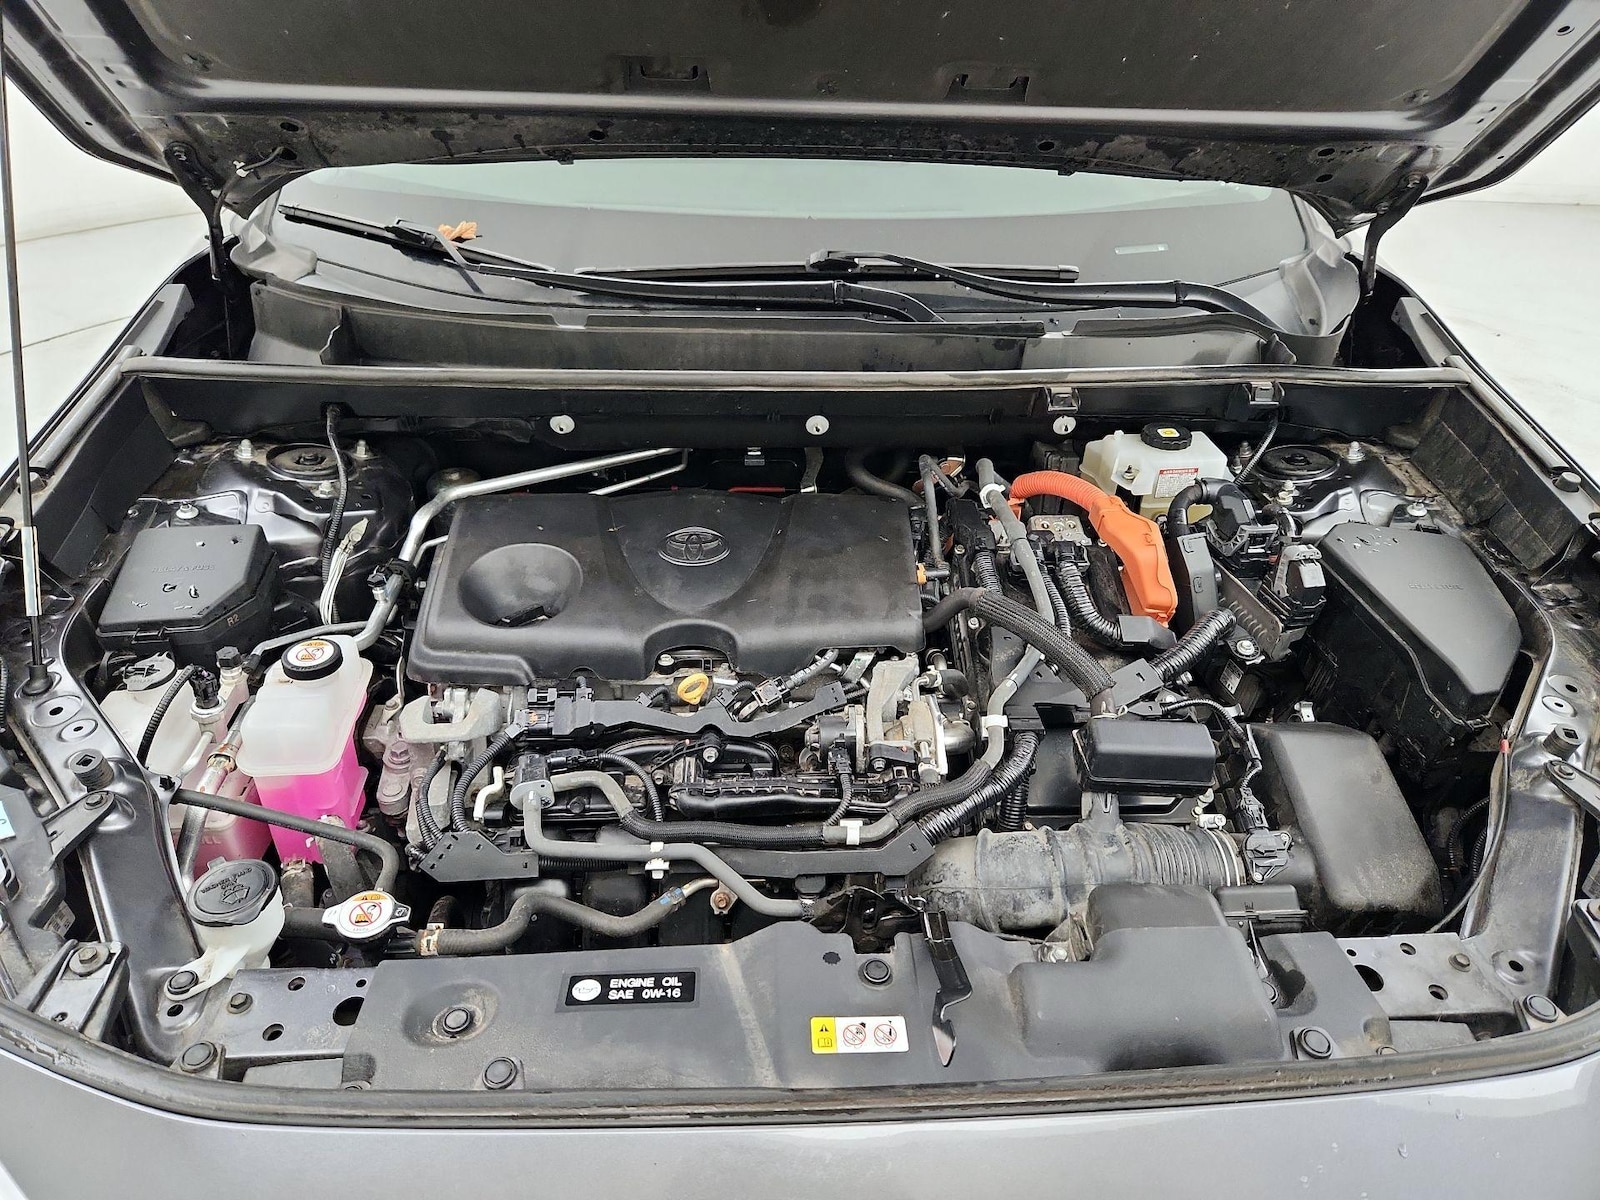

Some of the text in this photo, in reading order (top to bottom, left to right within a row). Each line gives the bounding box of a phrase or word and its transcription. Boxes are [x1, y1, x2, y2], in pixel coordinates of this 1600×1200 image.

[227, 613, 240, 627] R2
[1429, 704, 1441, 719] L3
[609, 976, 683, 988] ENGINE OIL
[608, 988, 682, 1000] SAE 0W-16
